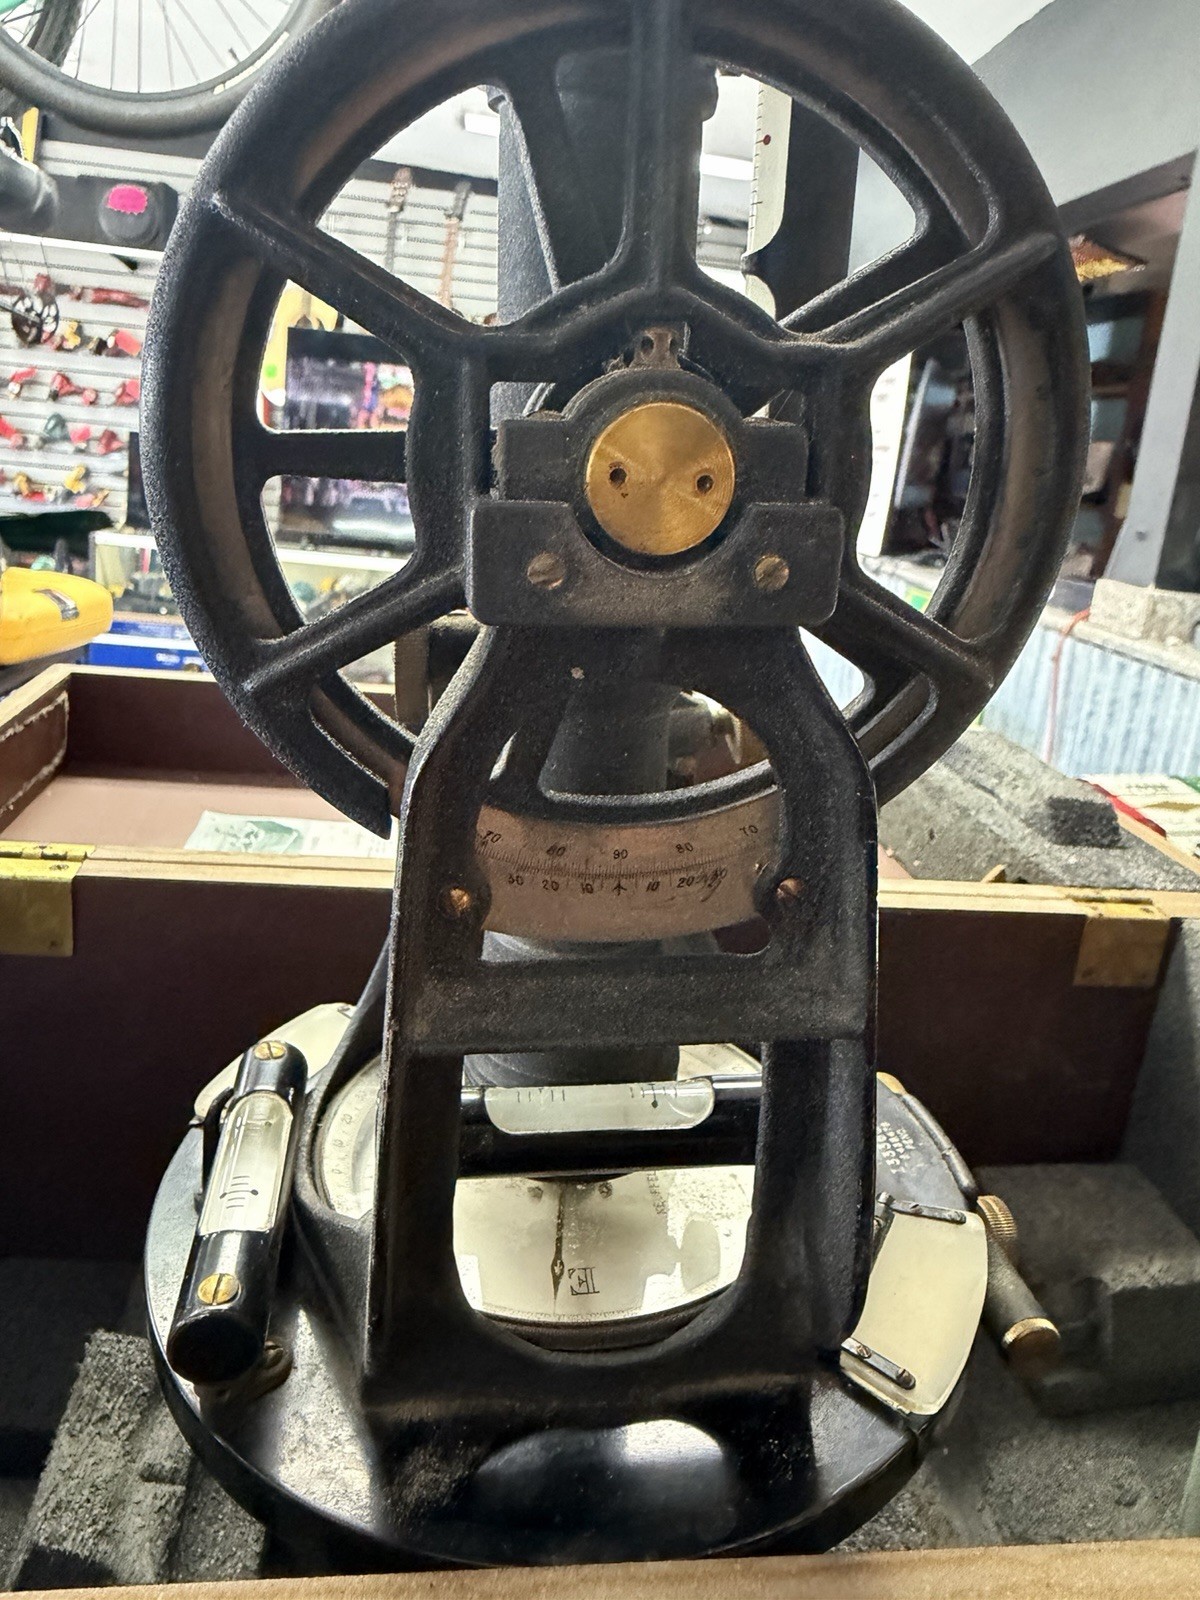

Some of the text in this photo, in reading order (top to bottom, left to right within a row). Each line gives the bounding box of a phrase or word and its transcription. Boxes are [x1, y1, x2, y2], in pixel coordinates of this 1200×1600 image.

[482, 829, 502, 844] 70
[612, 848, 629, 860] 90
[675, 841, 694, 854] 80
[739, 824, 759, 837] 70
[541, 879, 560, 892] 20
[580, 882, 594, 895] 10
[645, 880, 661, 893] 10
[676, 876, 695, 889] 20
